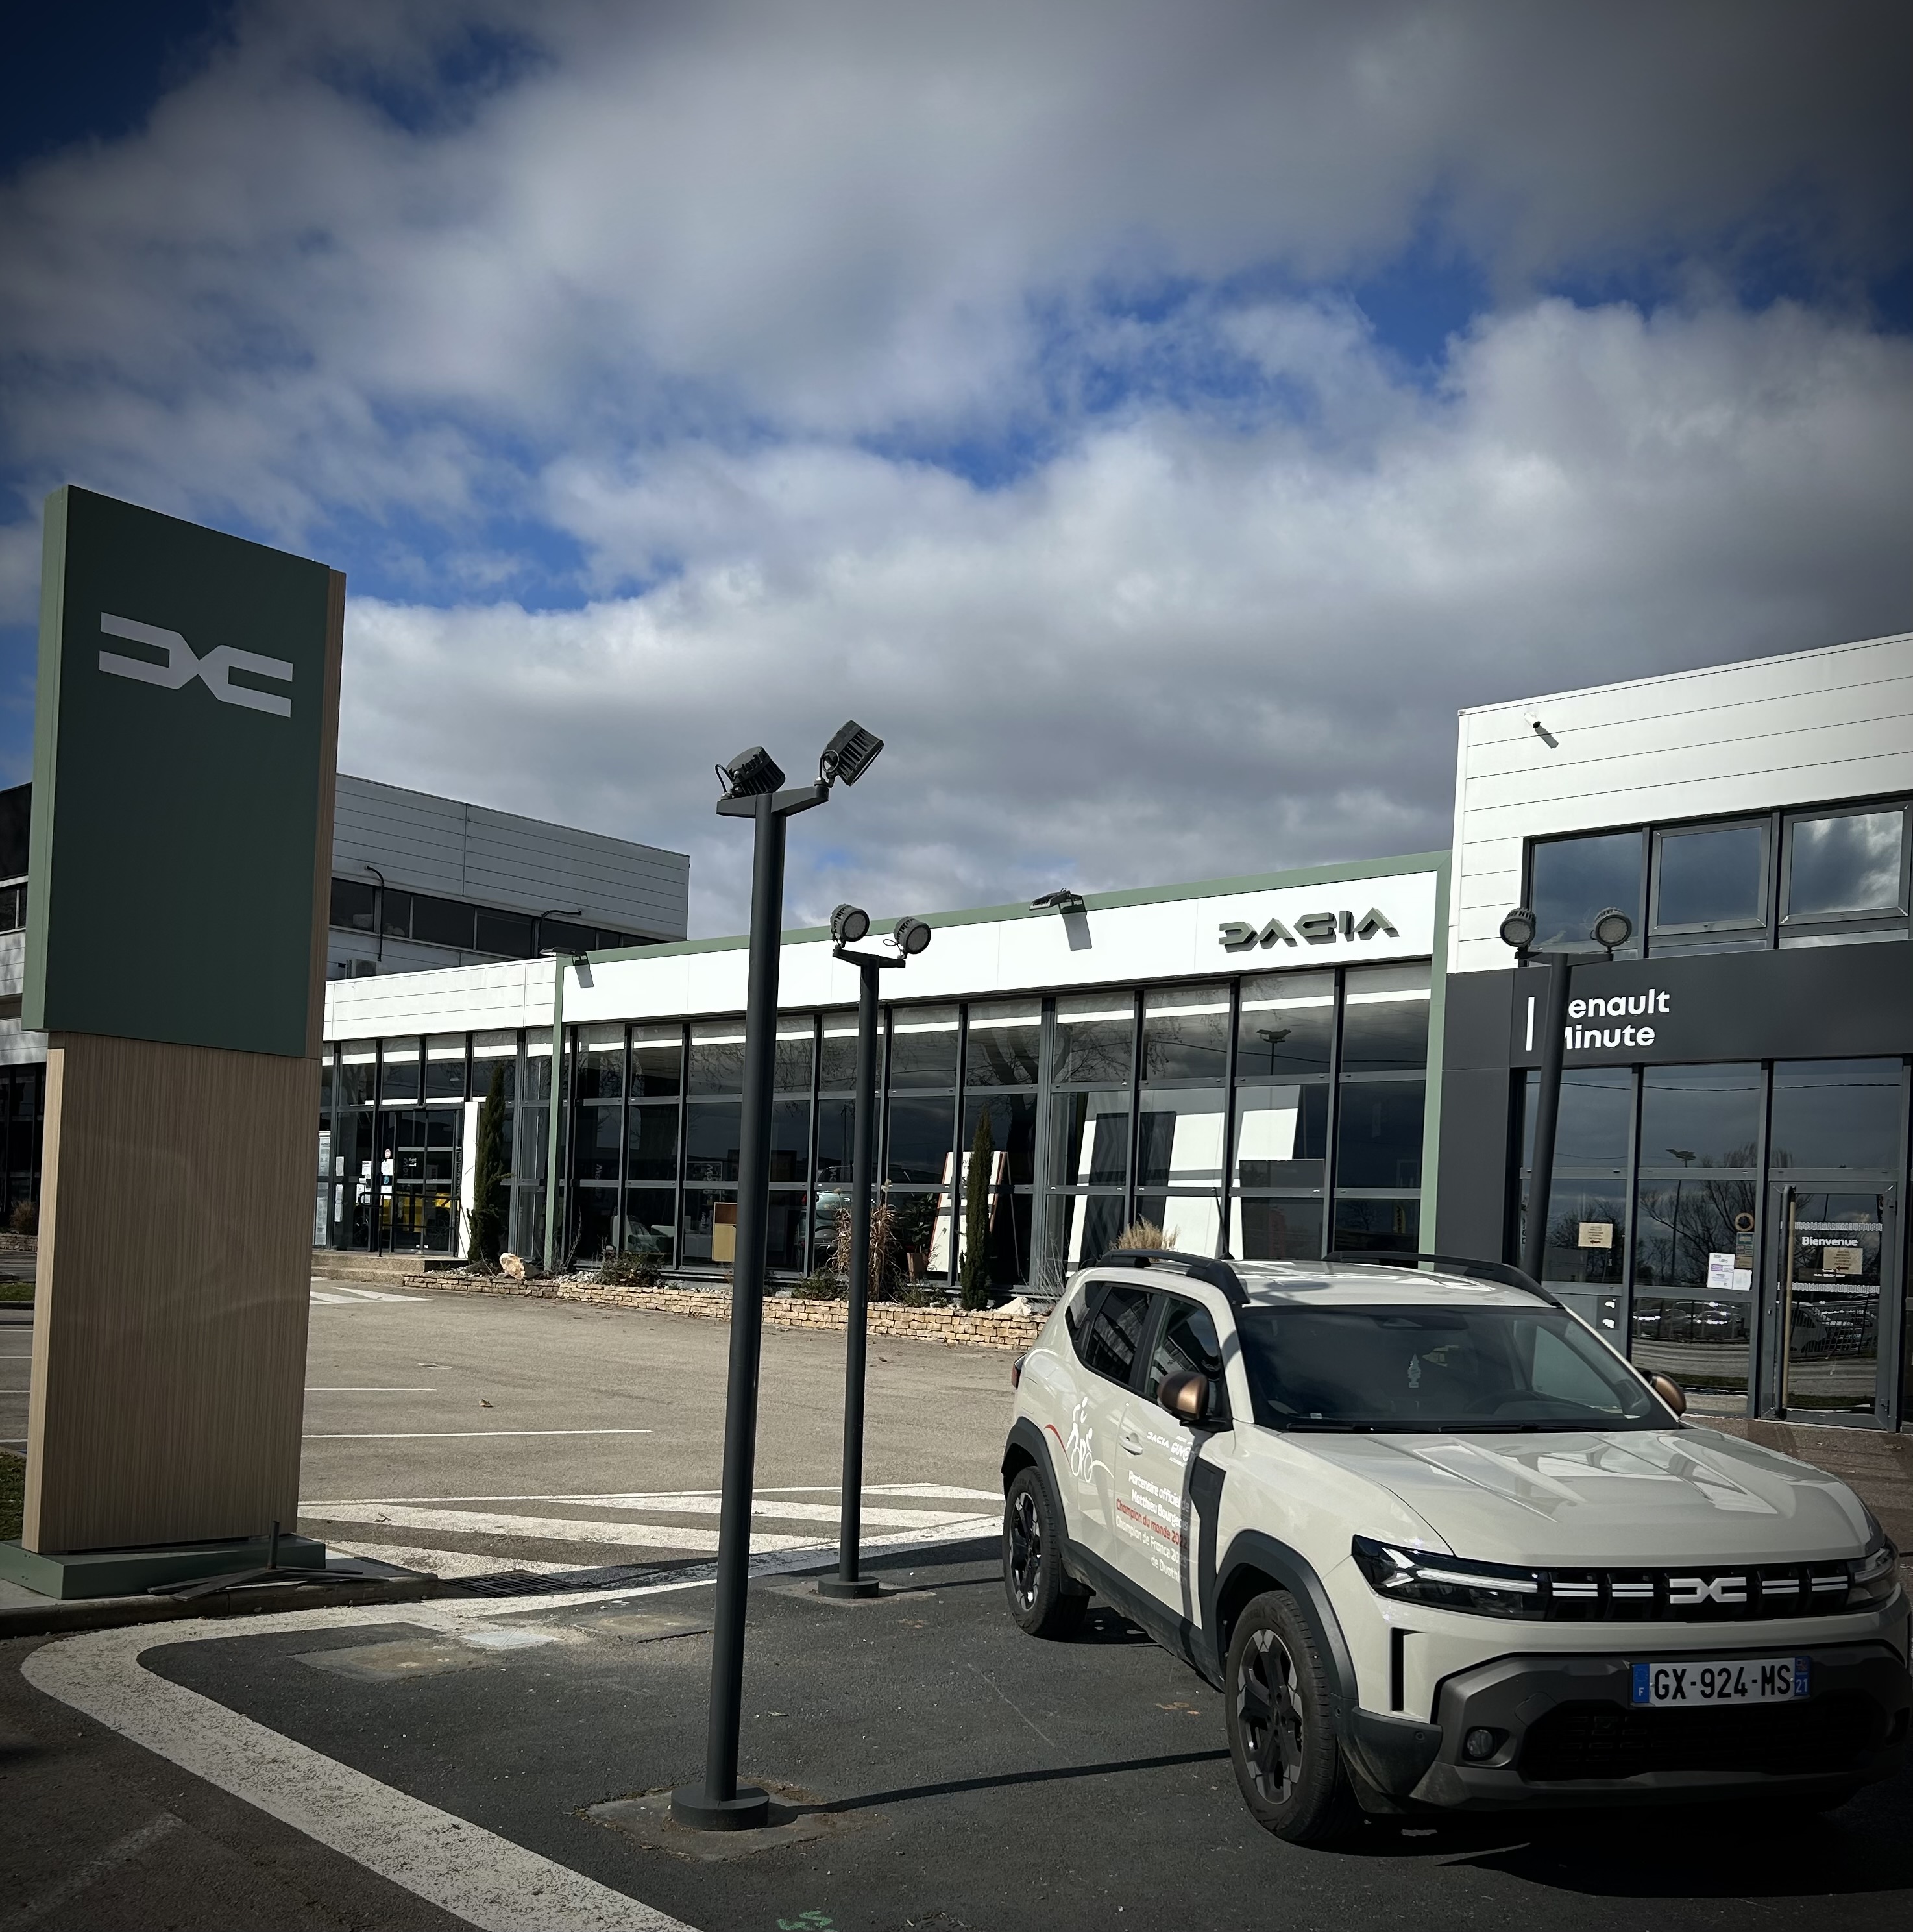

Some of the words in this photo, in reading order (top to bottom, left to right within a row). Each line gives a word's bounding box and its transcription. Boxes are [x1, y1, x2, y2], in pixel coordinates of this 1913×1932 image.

[1218, 907, 1400, 952] DACIA
[1568, 989, 1670, 1018] enault
[1801, 1236, 1858, 1247] Bienvenue
[1146, 1431, 1169, 1449] DACIA
[1128, 1469, 1159, 1497] Partenaire
[1158, 1488, 1181, 1509] officiel
[1116, 1498, 1142, 1523] Champion
[1143, 1515, 1151, 1528] du
[1151, 1521, 1171, 1541] monde
[1131, 1489, 1158, 1515] Matthieu
[1158, 1503, 1189, 1532] Bourgeois
[1116, 1515, 1142, 1541] Champion
[1142, 1532, 1150, 1546] de
[1150, 1535, 1171, 1559] France
[1151, 1555, 1160, 1570] de
[1638, 1687, 1644, 1697] F
[1654, 1664, 1791, 1700] GX-924-MS
[1796, 1678, 1808, 1694] 21
